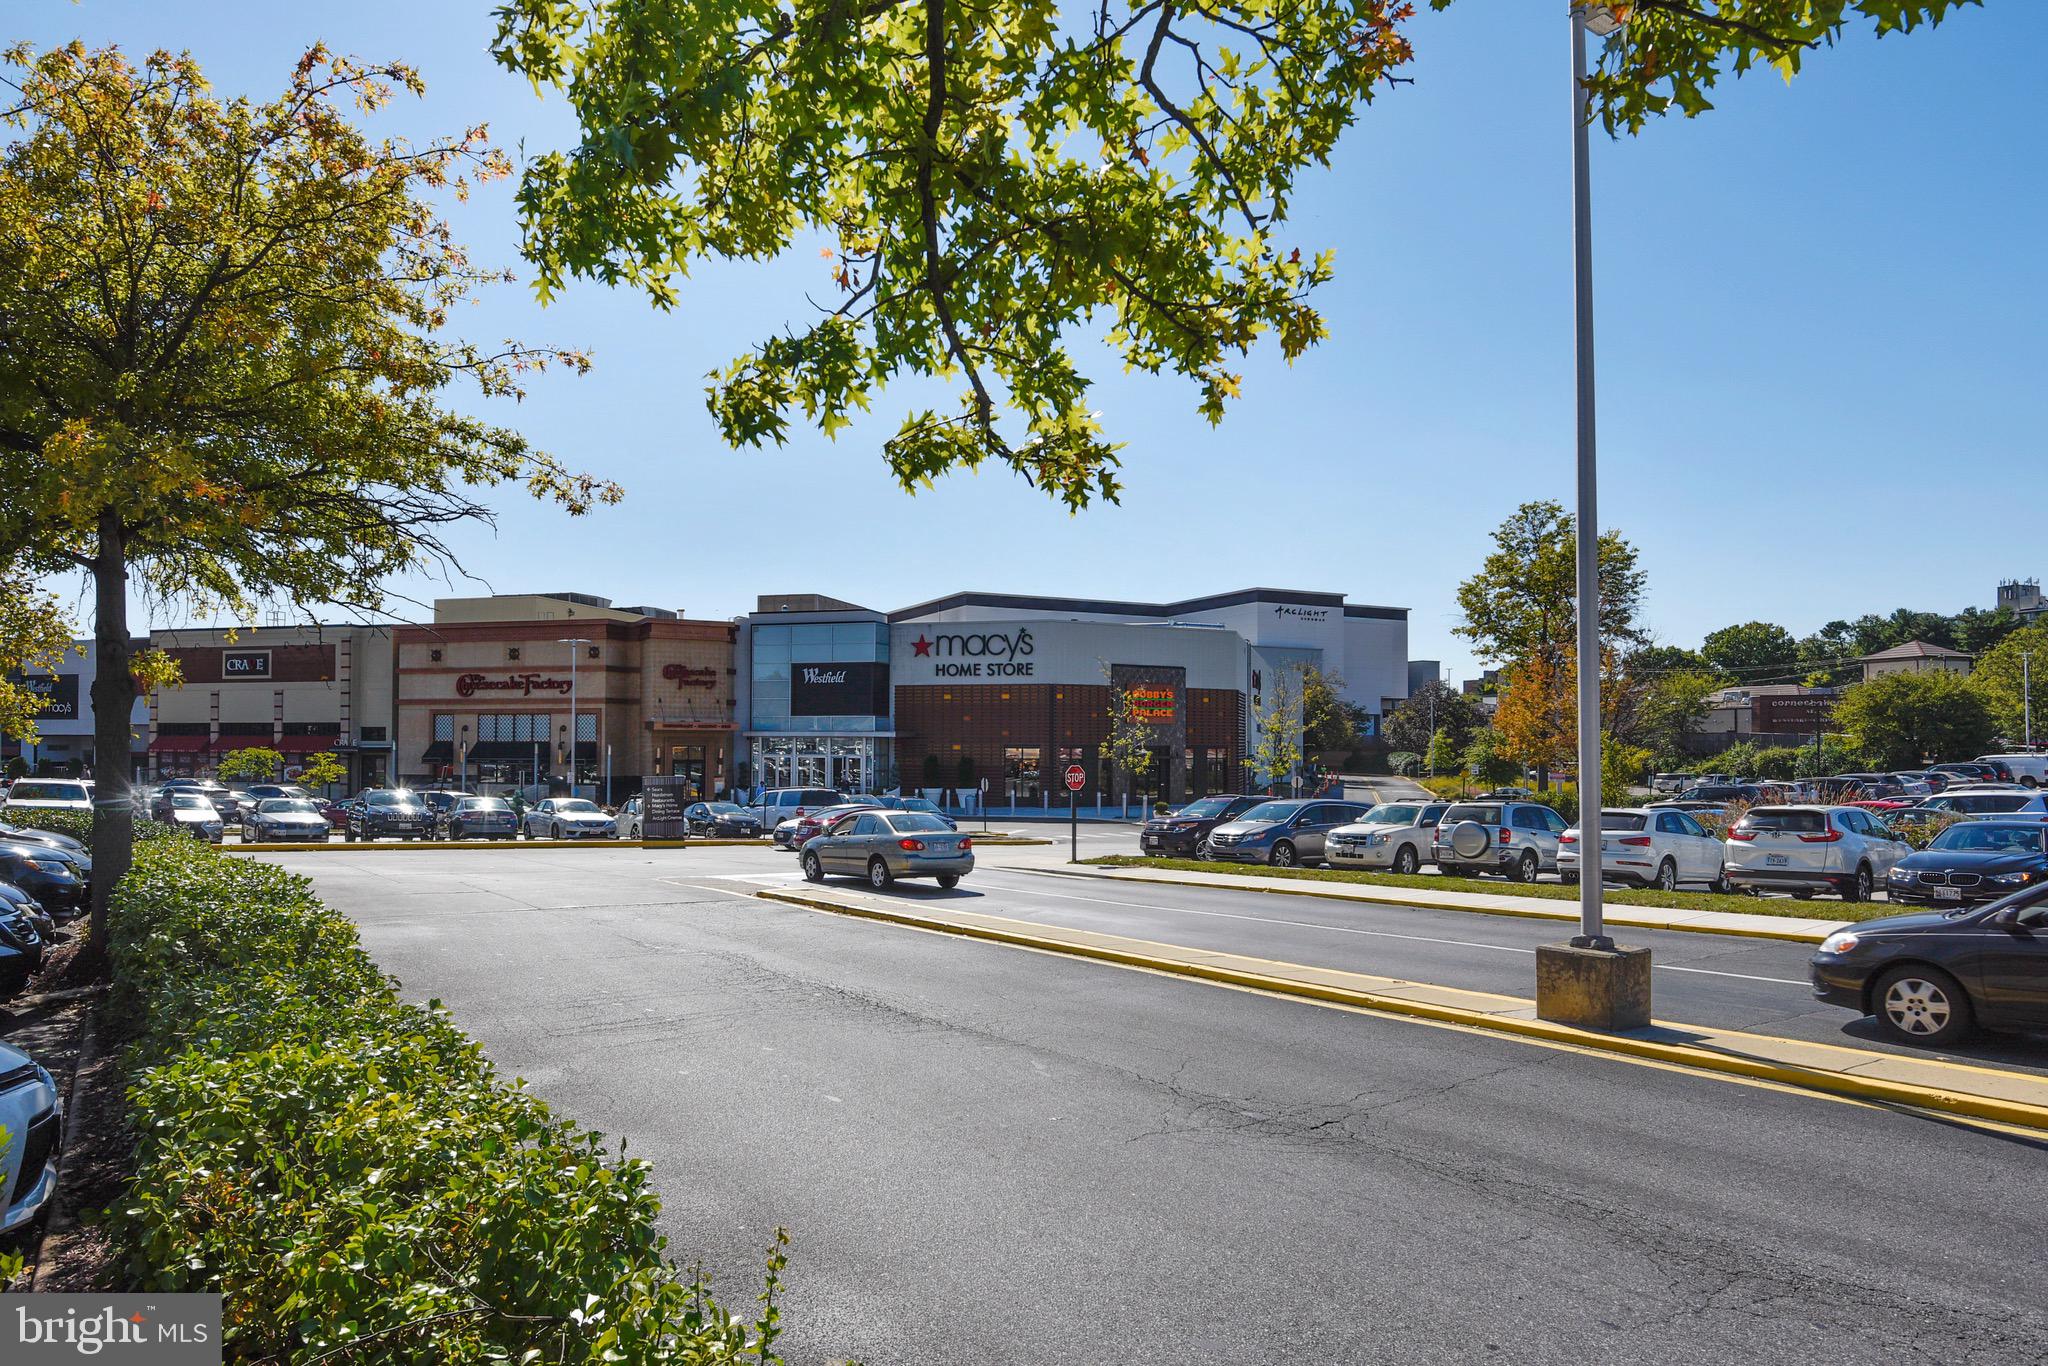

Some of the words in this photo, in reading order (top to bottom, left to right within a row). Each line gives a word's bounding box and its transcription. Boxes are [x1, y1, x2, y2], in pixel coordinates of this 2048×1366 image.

[936, 627, 1034, 662] macy's
[802, 667, 847, 684] Westfield
[936, 663, 981, 676] HOME
[987, 663, 1034, 676] STORE
[456, 674, 525, 697] Cheesecake
[519, 673, 573, 696] Factory
[1132, 709, 1174, 717] PALACE
[1067, 773, 1084, 783] STOP
